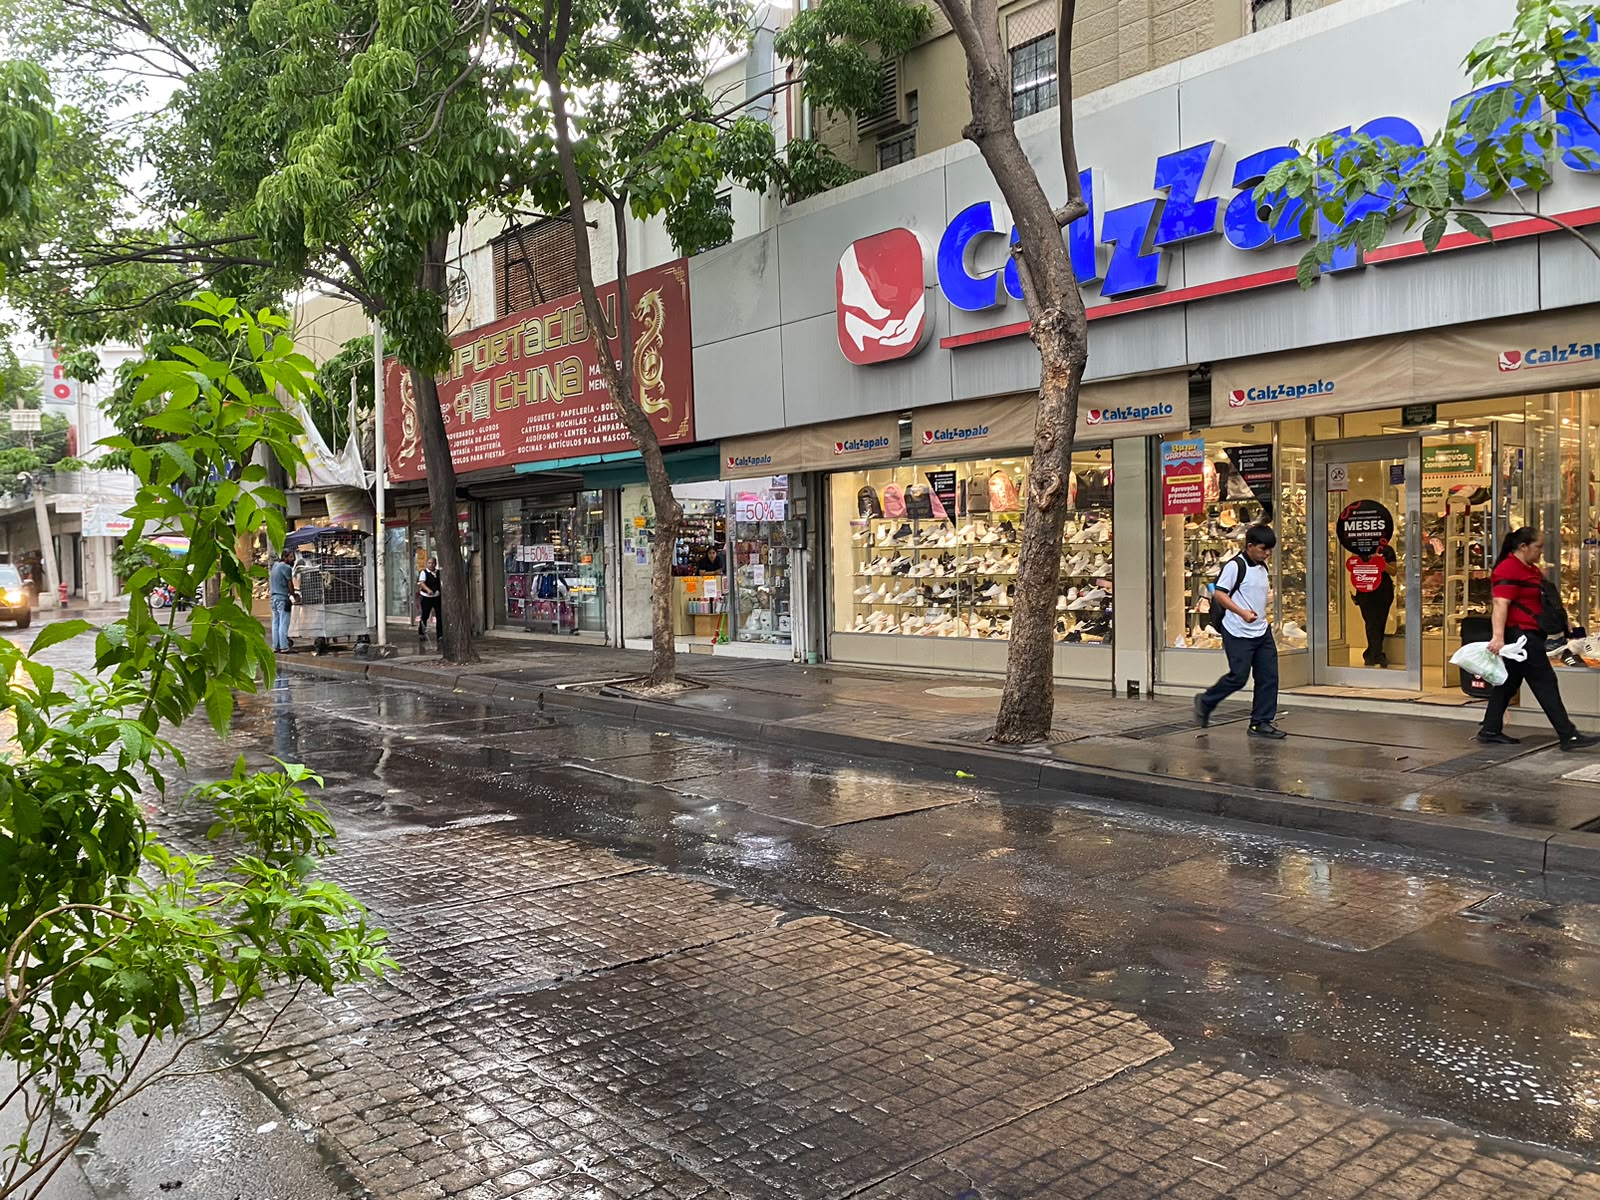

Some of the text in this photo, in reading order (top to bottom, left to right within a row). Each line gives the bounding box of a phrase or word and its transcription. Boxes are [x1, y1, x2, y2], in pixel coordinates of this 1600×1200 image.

[527, 412, 555, 424] JUGUETES
[561, 404, 595, 418] PAPELERÍA
[479, 424, 499, 434] GLOBOS
[521, 412, 619, 434] CARTERAS MOCHILAS CABLES
[483, 432, 500, 441] ACERO
[525, 431, 559, 443] AUDÍFONOS
[564, 427, 587, 438] LENTES
[517, 443, 543, 454] BOCINAS
[548, 437, 582, 450] ARTÍCULOS
[583, 436, 601, 445] PARA
[470, 454, 483, 462] PARA
[484, 449, 506, 459] FIESTAS
[736, 501, 774, 521] -50%
[1344, 520, 1386, 531] MESES
